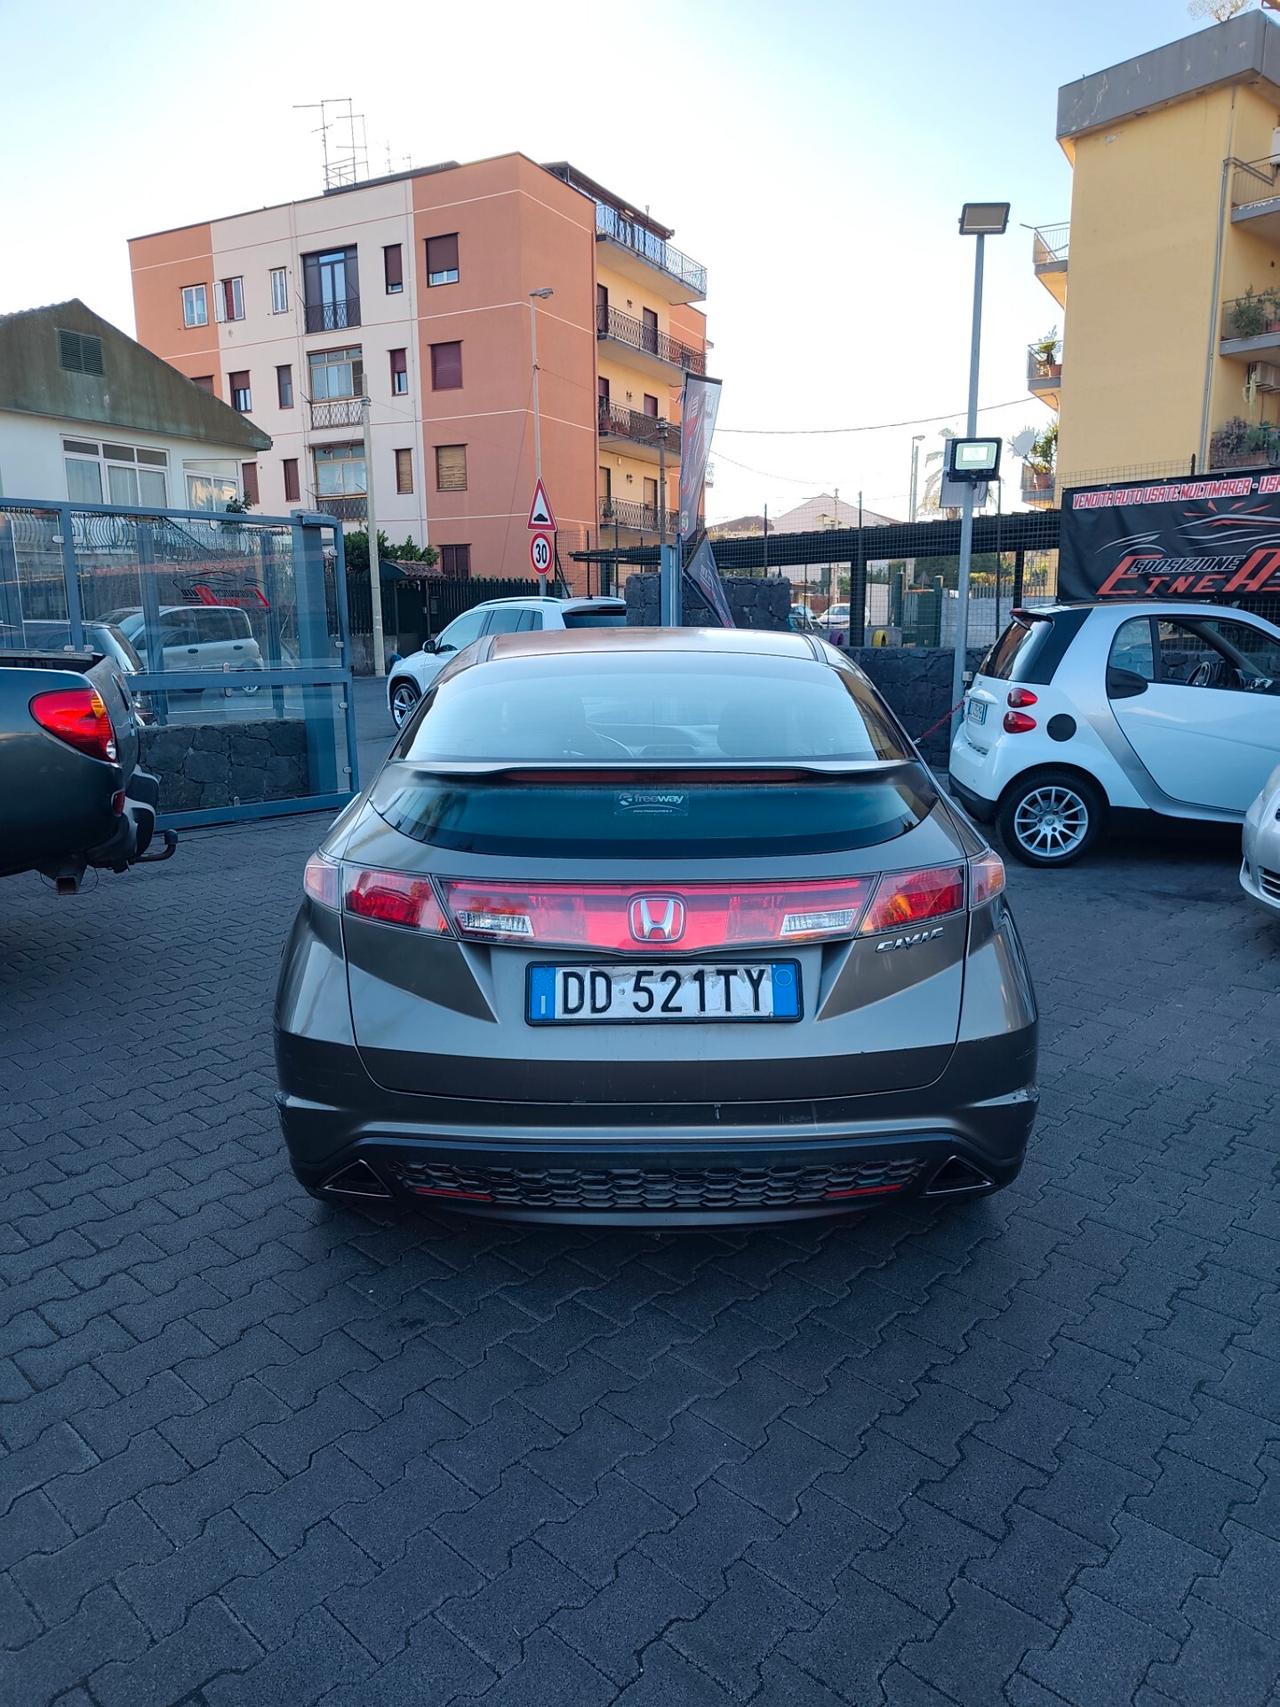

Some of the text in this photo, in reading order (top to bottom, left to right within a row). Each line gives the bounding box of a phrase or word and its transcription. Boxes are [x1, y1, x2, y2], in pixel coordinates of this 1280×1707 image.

[1072, 490, 1115, 510] VENDITA
[1114, 488, 1144, 506] AUTO
[1143, 484, 1181, 504] USATE
[1179, 477, 1253, 501] MULTIMARCA
[535, 543, 548, 565] 30
[633, 793, 684, 804] freeway
[875, 926, 944, 953] CIVIC
